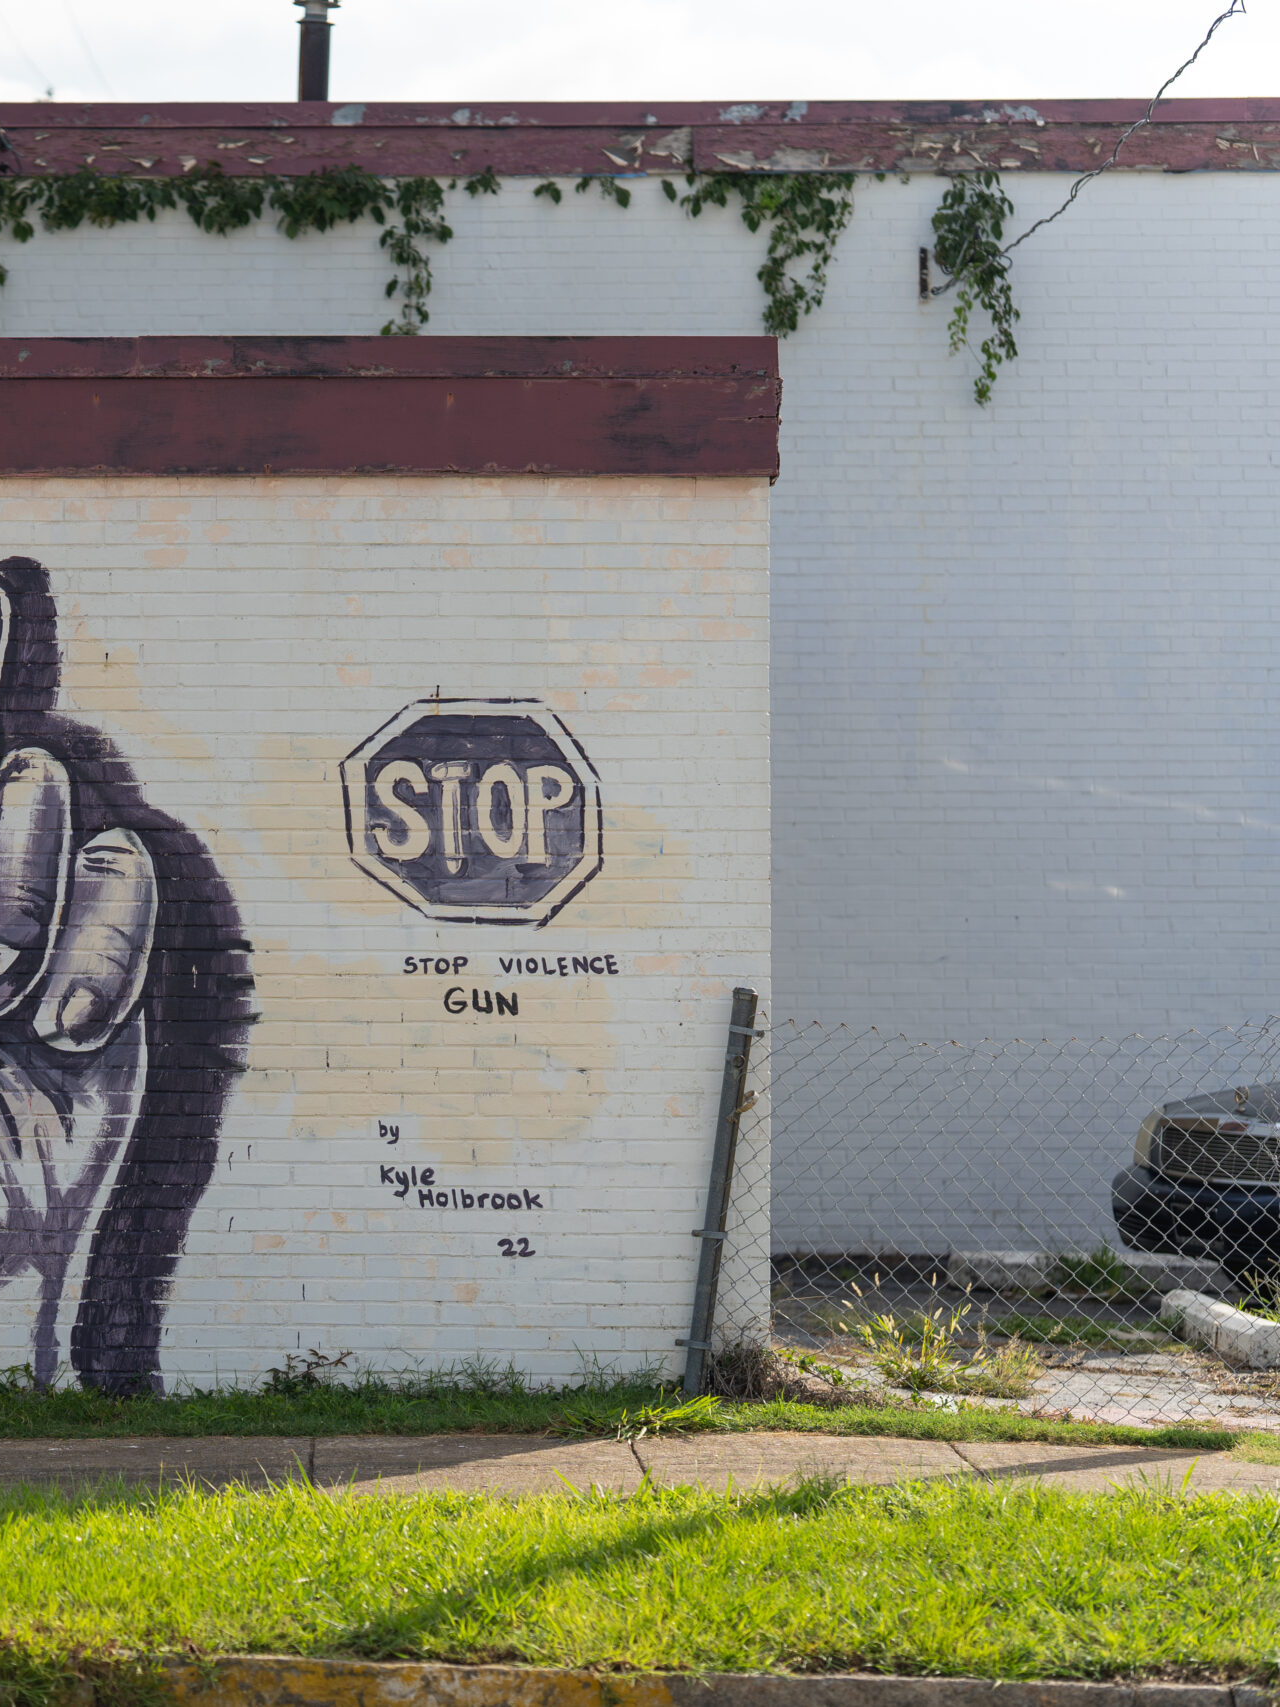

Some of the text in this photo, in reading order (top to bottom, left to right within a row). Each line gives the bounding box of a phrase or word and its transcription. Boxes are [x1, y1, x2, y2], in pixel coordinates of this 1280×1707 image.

[373, 760, 575, 875] STOP
[403, 954, 620, 976] STOP VIOLENCE
[443, 986, 519, 1016] GUN
[378, 1120, 400, 1145] by
[380, 1165, 436, 1197] Kyle
[418, 1188, 543, 1210] Holbrook
[497, 1237, 536, 1258] 22
